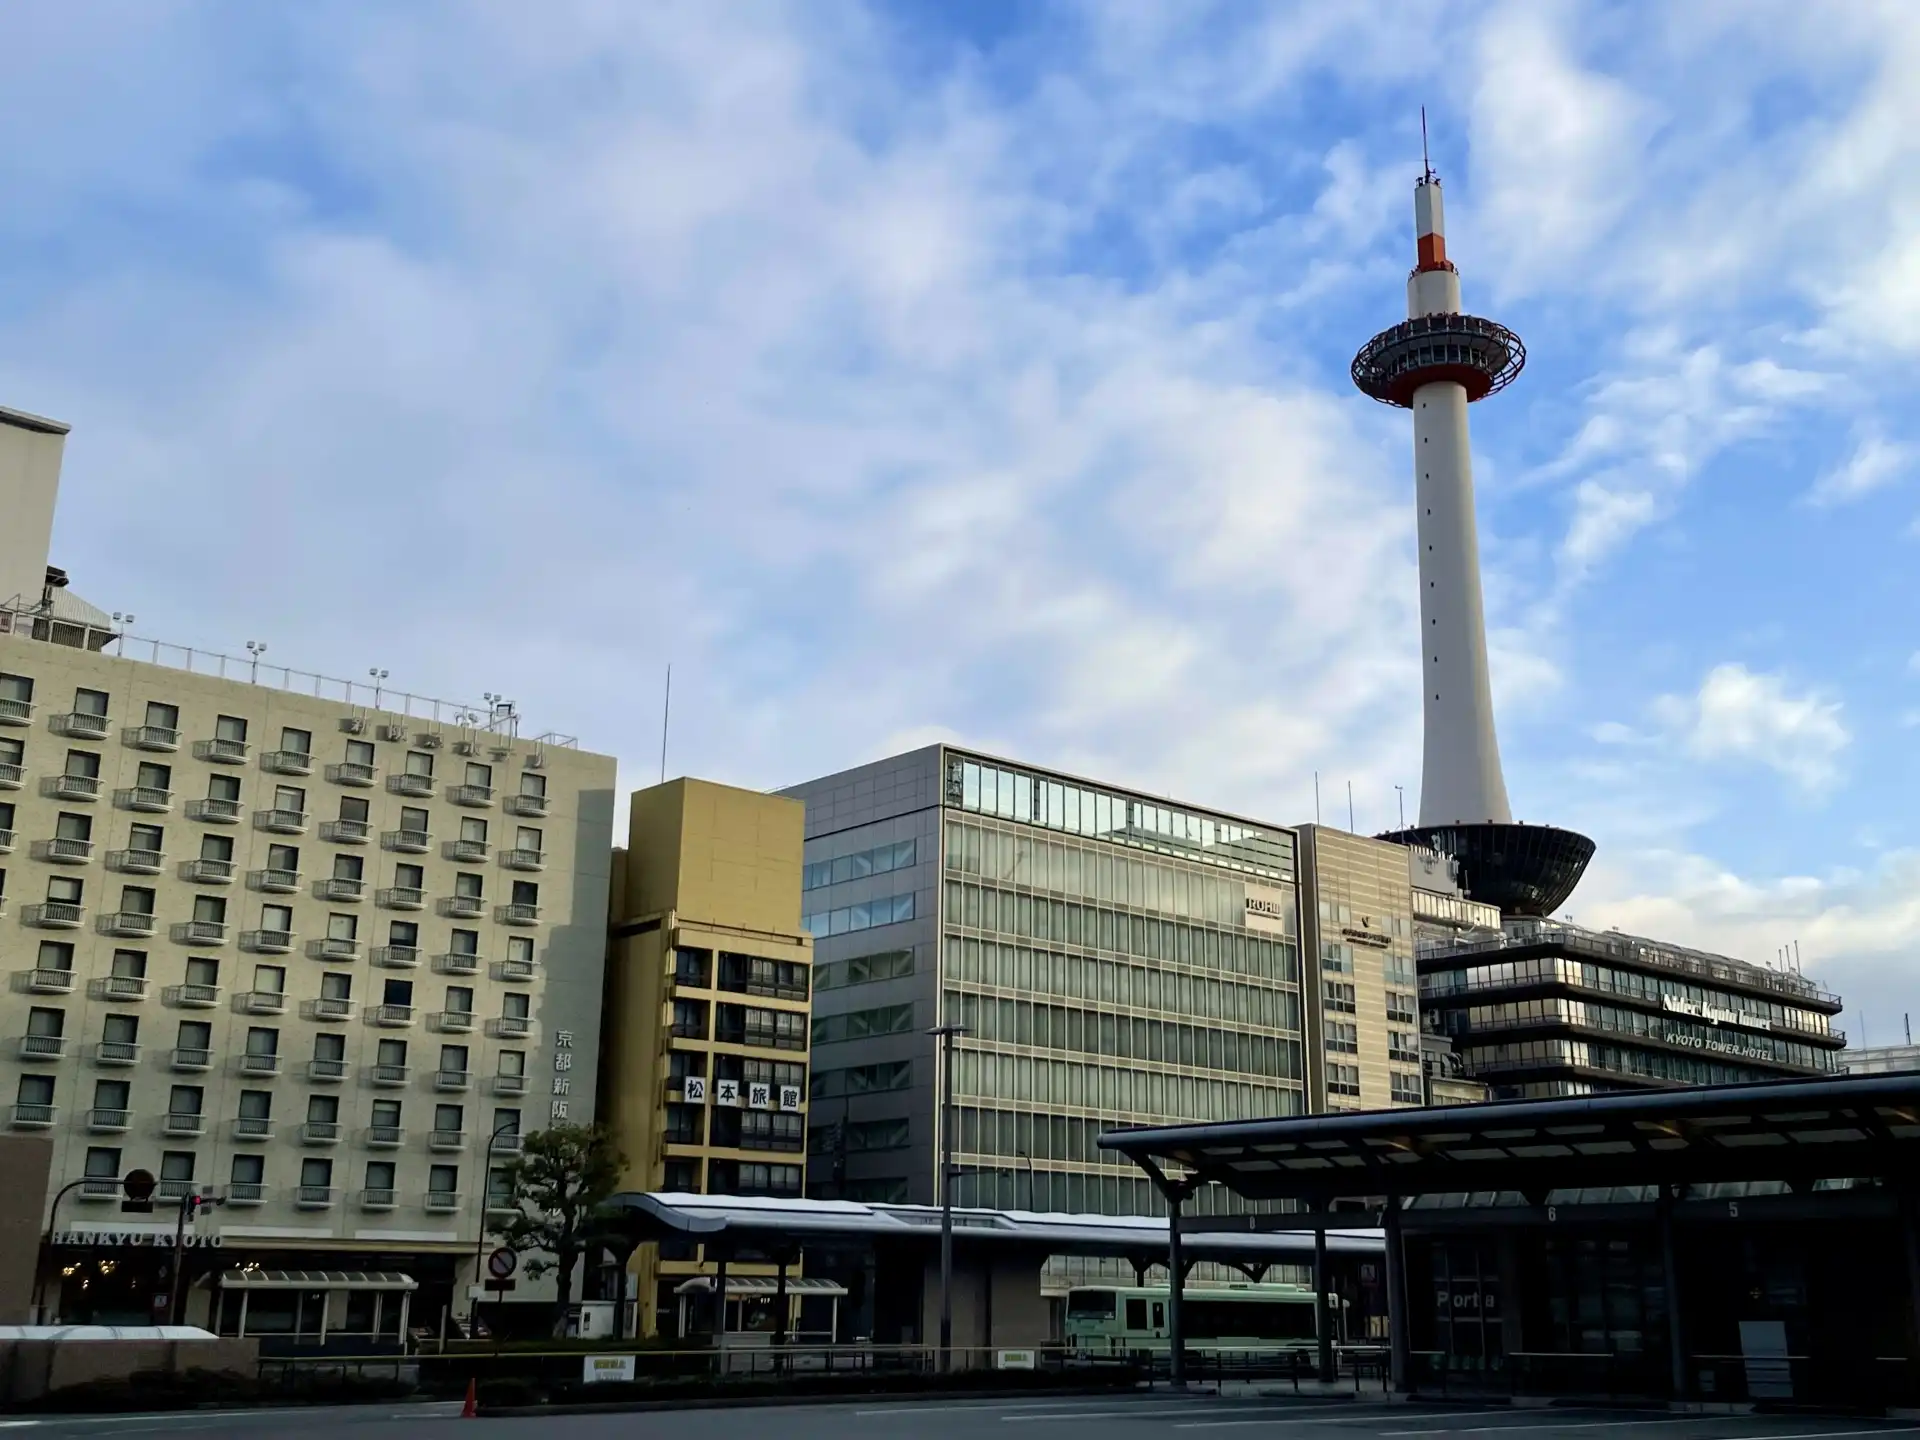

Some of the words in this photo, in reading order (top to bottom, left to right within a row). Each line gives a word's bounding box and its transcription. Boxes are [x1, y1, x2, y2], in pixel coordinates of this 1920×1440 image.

[1702, 1001, 1738, 1025] Kyoto
[1666, 1033, 1702, 1048] KYOTO
[1705, 1039, 1741, 1055] TOWER
[1742, 1046, 1774, 1062] HOTEL
[549, 1029, 573, 1121] 京都新阪
[687, 1079, 798, 1107] 松本旅館
[1548, 1206, 1556, 1222] 6
[1729, 1202, 1738, 1218] 5
[52, 1231, 143, 1246] HANKYU
[153, 1233, 223, 1248] KYOTO
[1436, 1290, 1495, 1309] Porta
